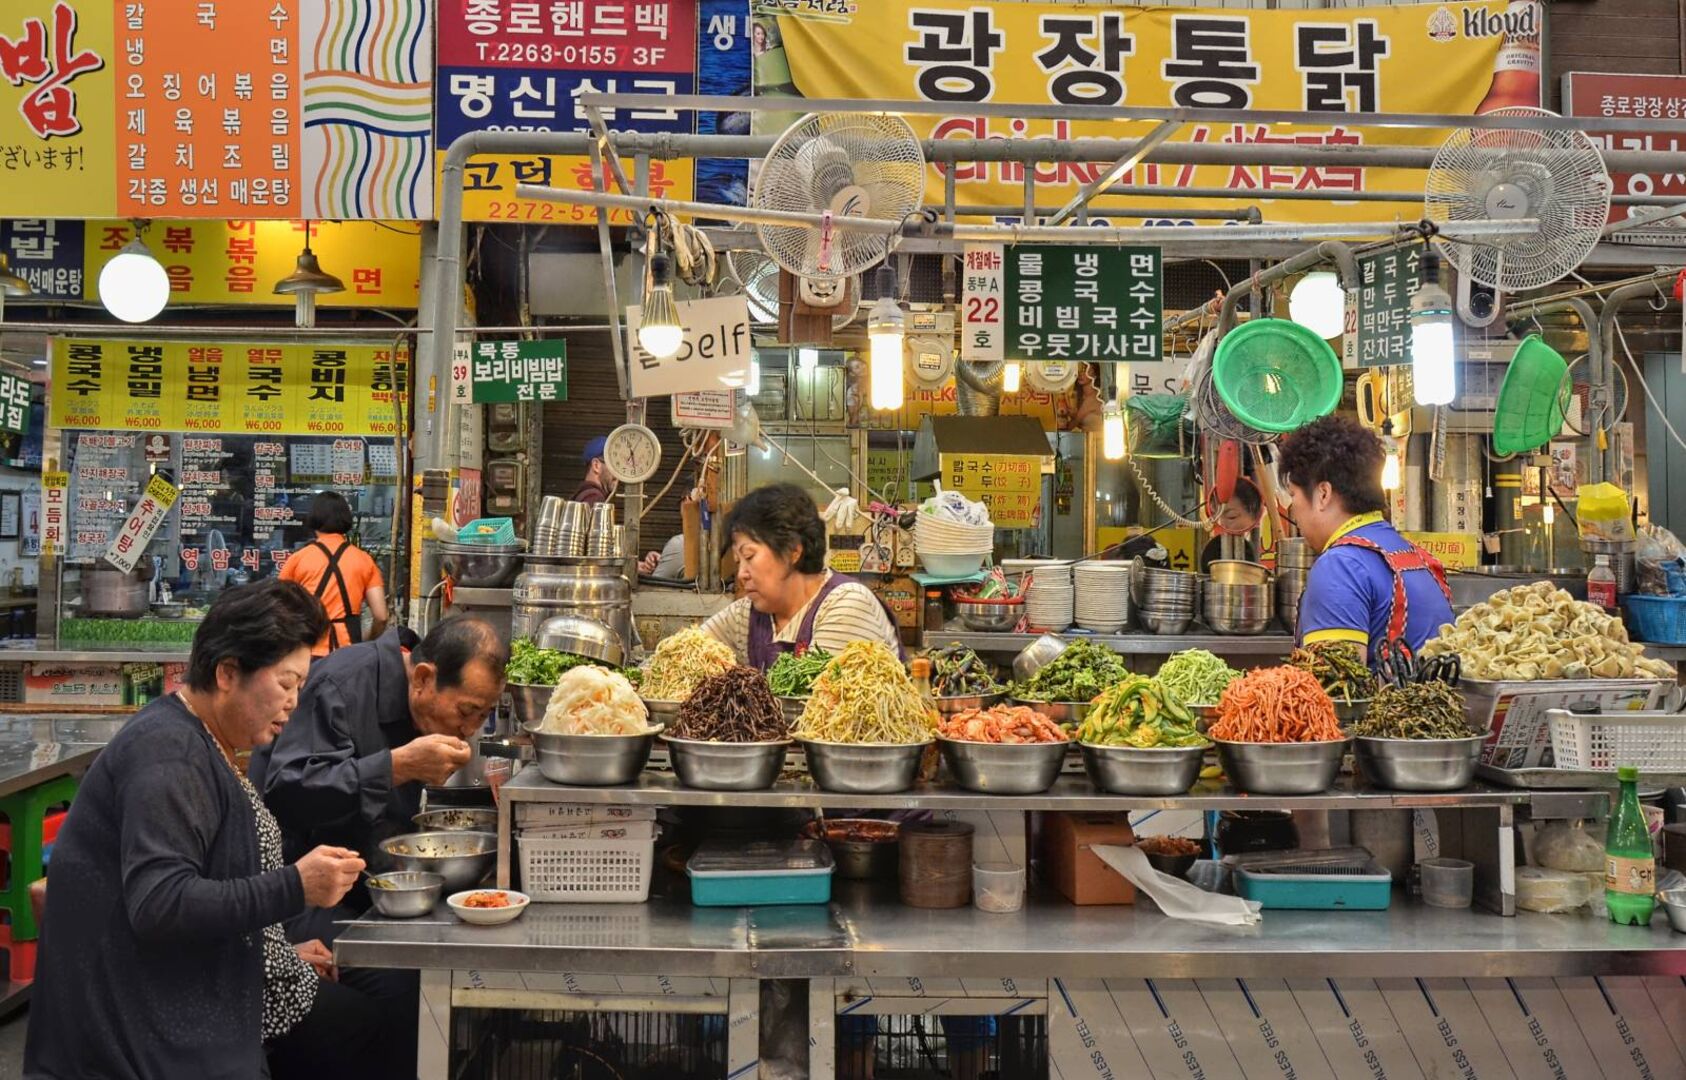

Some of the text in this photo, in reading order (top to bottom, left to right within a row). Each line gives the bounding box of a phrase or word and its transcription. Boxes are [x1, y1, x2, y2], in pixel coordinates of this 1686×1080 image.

[125, 3, 289, 29] 칼국수
[464, 0, 668, 41] 종로핸드백
[1462, 3, 1536, 38] Kloud
[126, 38, 289, 66] 냉면
[475, 42, 667, 65] T.2263-0155 3F
[906, 10, 1388, 112] 광장통닭
[126, 73, 290, 101] 오징어볶음
[450, 74, 679, 121] 명신실크
[126, 108, 290, 136] 제육볶음
[0, 146, 83, 171] ざいます!
[127, 143, 290, 170] 갈치조림
[128, 178, 291, 206] 각종 생선 매운탕
[966, 251, 1001, 271] 계절메뉴
[1017, 253, 1155, 278] 물냉면
[1363, 250, 1420, 284] 칼국수
[967, 277, 999, 292] 동부 A
[1017, 280, 1156, 304] 콩국수
[967, 296, 999, 323] 22
[1018, 305, 1156, 330] 비빔국수
[1344, 309, 1357, 334] 22
[973, 330, 992, 349] 호
[1346, 340, 1354, 357] 호
[66, 344, 103, 396] 콩국수
[247, 348, 284, 365] 열무
[127, 345, 163, 399] 냉모밀
[186, 366, 221, 402] 냉면
[246, 366, 284, 402] 국수
[307, 350, 347, 403] 콩비지
[453, 366, 467, 381] 39
[473, 357, 565, 384] 보리비빔밥
[456, 385, 467, 398] 호
[516, 383, 558, 401] 전문
[64, 415, 101, 426] ₩6,000
[125, 417, 161, 428] ₩6,000
[185, 418, 221, 429] ₩6,000
[245, 420, 282, 431] ₩6,000
[307, 421, 344, 432] ₩6,000
[952, 460, 993, 473] 칼국수
[46, 488, 63, 542] 모듬회
[182, 503, 212, 516] 삼계탕
[117, 498, 156, 553] 추어탕
[1075, 1018, 1096, 1048] STEEL
[1167, 1018, 1188, 1048] STEEL
[1258, 1018, 1280, 1048] STEEL
[1348, 1018, 1369, 1048] STEEL
[1436, 1017, 1458, 1047] STEEL
[1527, 1017, 1548, 1047] STEEL
[1614, 1015, 1635, 1045] STEEL
